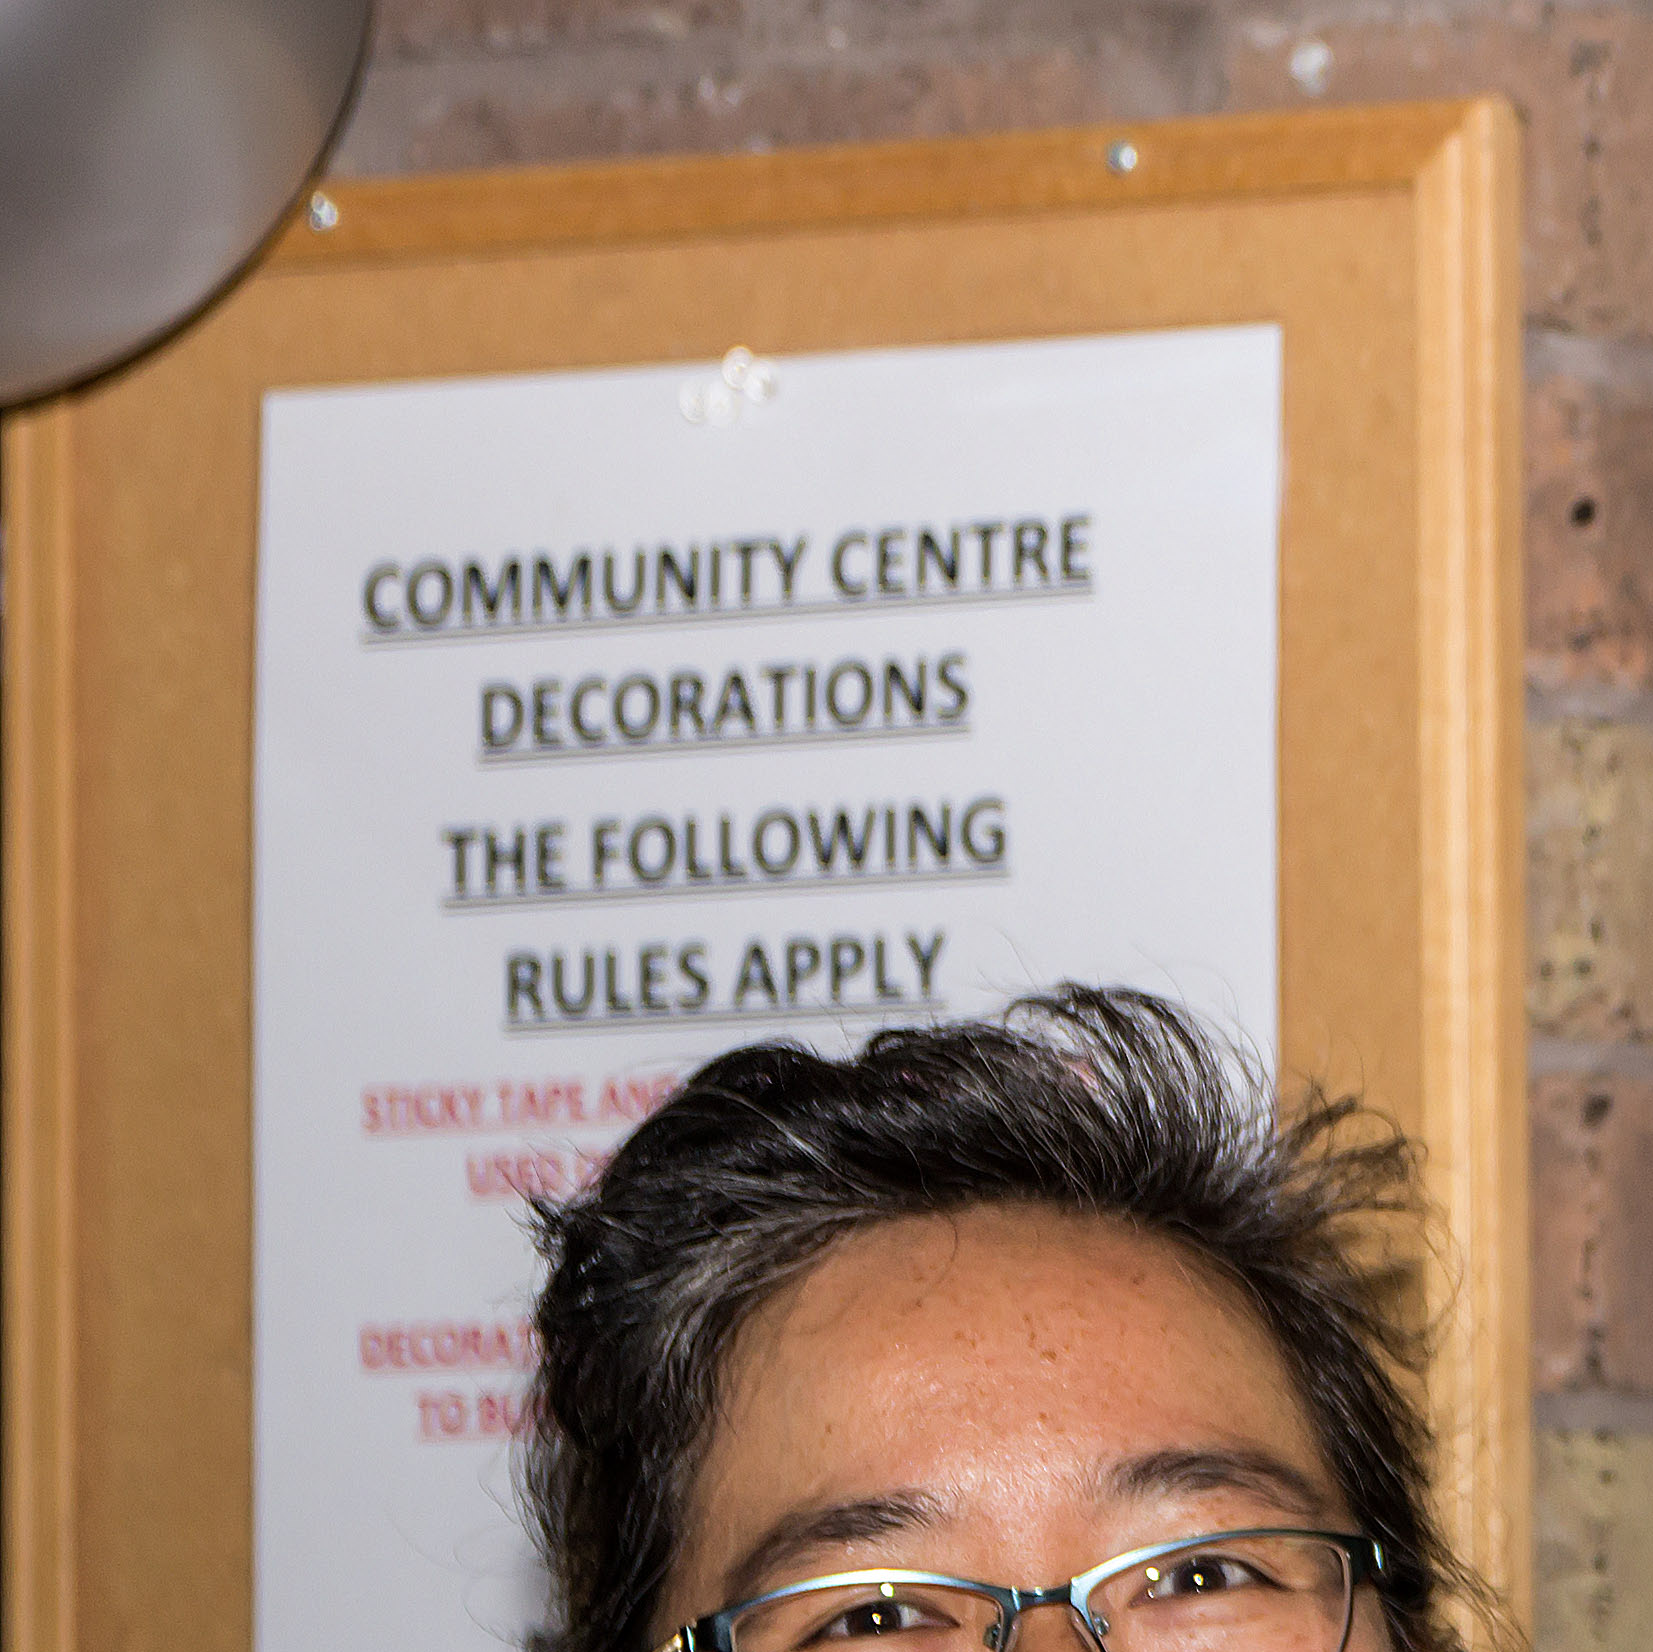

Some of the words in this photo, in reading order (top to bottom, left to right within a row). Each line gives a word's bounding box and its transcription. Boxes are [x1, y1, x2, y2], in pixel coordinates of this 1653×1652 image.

[361, 534, 808, 637] COMMUNITY
[829, 513, 1094, 605] CENTRE
[479, 652, 971, 755] DECORATIONS
[441, 822, 567, 900] THE
[596, 796, 1006, 892] FOLLOWING
[505, 940, 710, 1025] RULES
[733, 930, 946, 1010] APPLY
[416, 1390, 466, 1438] TO
